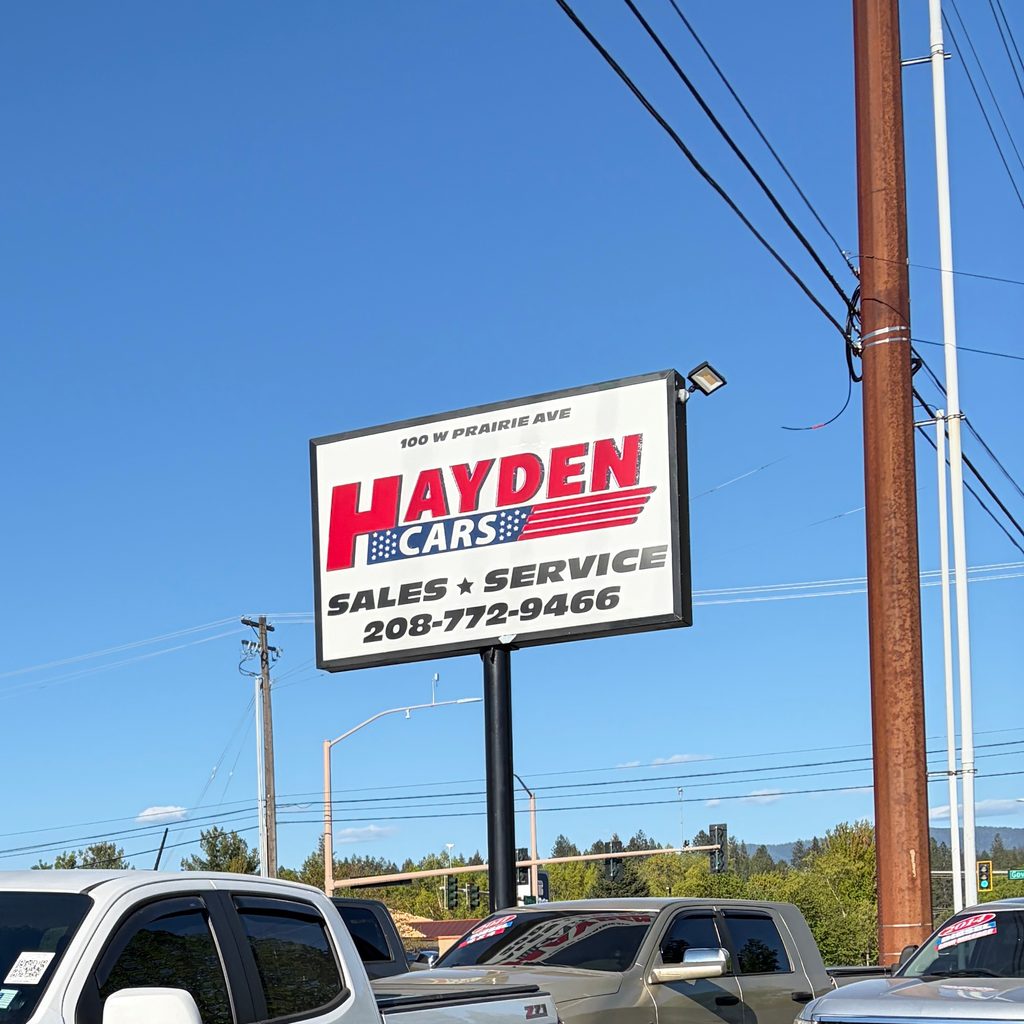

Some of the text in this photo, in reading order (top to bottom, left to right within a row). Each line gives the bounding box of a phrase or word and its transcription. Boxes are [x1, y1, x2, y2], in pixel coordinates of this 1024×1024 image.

[400, 407, 572, 449] 100 W PRAIRIE AVE
[326, 433, 644, 572] HAYDEN
[398, 514, 498, 556] CARS
[327, 544, 669, 617] SALES SERVICE
[362, 585, 622, 644] 208-772-9466
[524, 1003, 548, 1020] Z71
